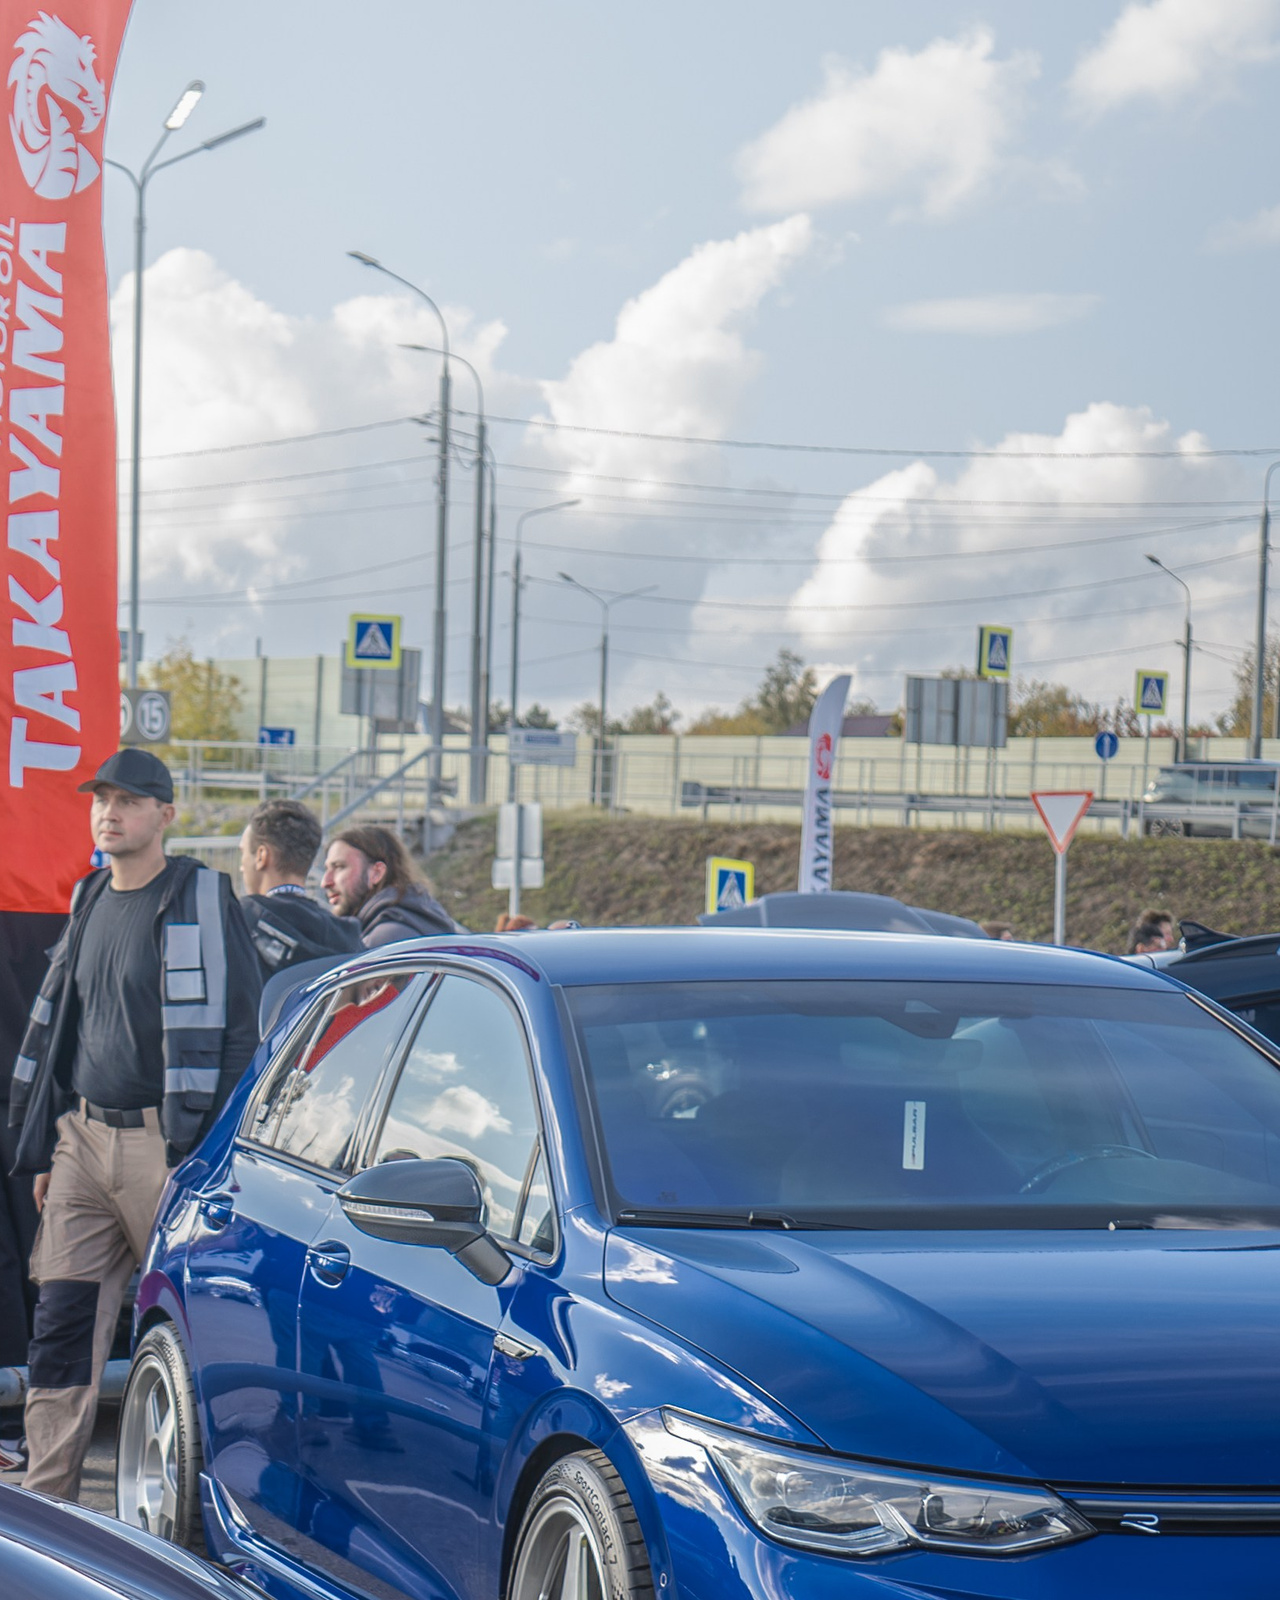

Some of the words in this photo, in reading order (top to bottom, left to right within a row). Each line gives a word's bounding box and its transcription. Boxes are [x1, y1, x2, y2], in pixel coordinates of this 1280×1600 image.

[7, 221, 81, 788] TAKAYAMA
[141, 699, 165, 732] 15
[811, 787, 831, 894] AYAMA
[572, 1470, 615, 1553] SportContact
[608, 1553, 618, 1566] 7
